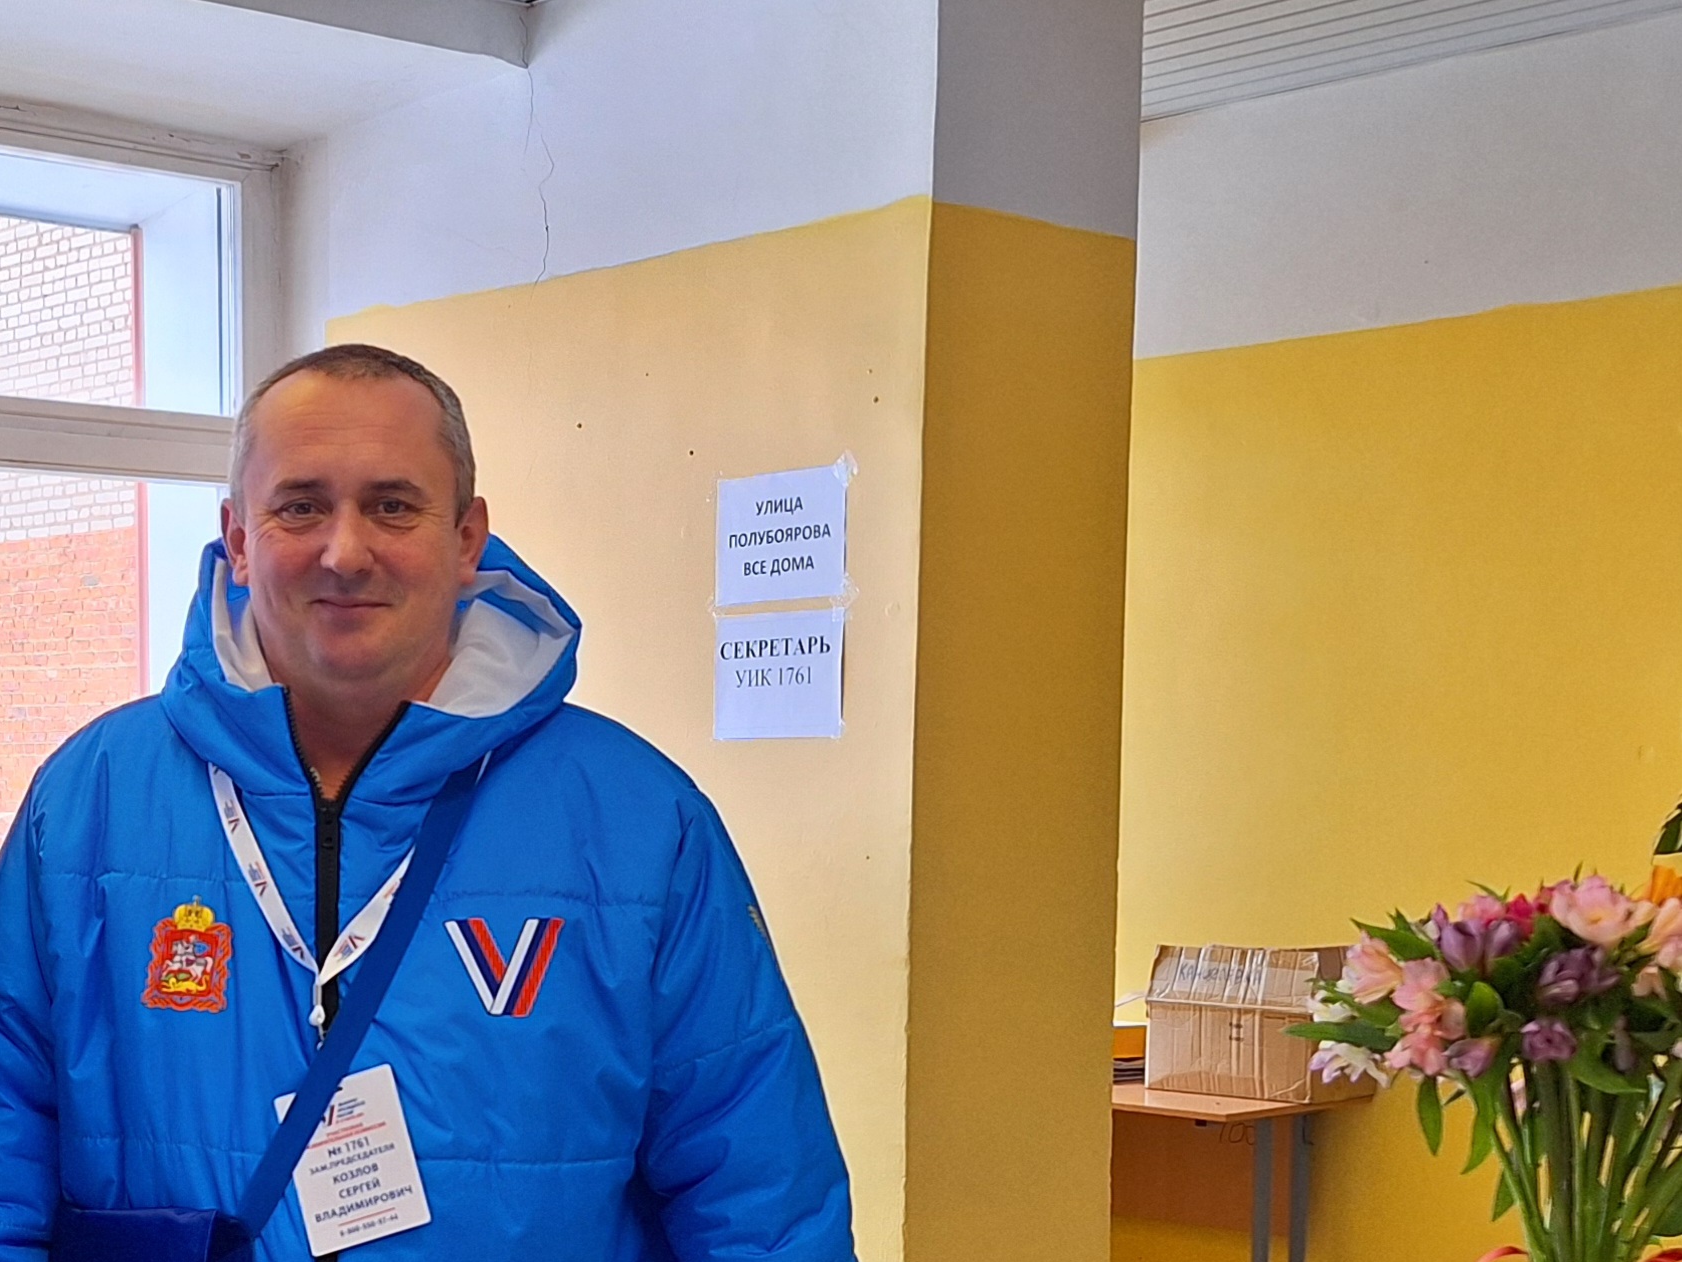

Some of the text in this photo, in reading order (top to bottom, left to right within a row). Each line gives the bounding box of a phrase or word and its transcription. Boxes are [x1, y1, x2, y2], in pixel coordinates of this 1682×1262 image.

[755, 496, 804, 516] УЛИЦА
[728, 523, 832, 549] ПОЛУБОЯРОВА
[743, 555, 815, 577] ВСЕ ДОМА
[719, 635, 831, 661] СЕКРЕТАРЬ
[735, 666, 812, 688] УИК 1761
[345, 1136, 370, 1152] 1761
[333, 1163, 379, 1184] КОЗЛОВ
[339, 1177, 381, 1199] СЕРГЕЙ
[315, 1185, 413, 1222] ВЛАДИМИРОВИЧ
